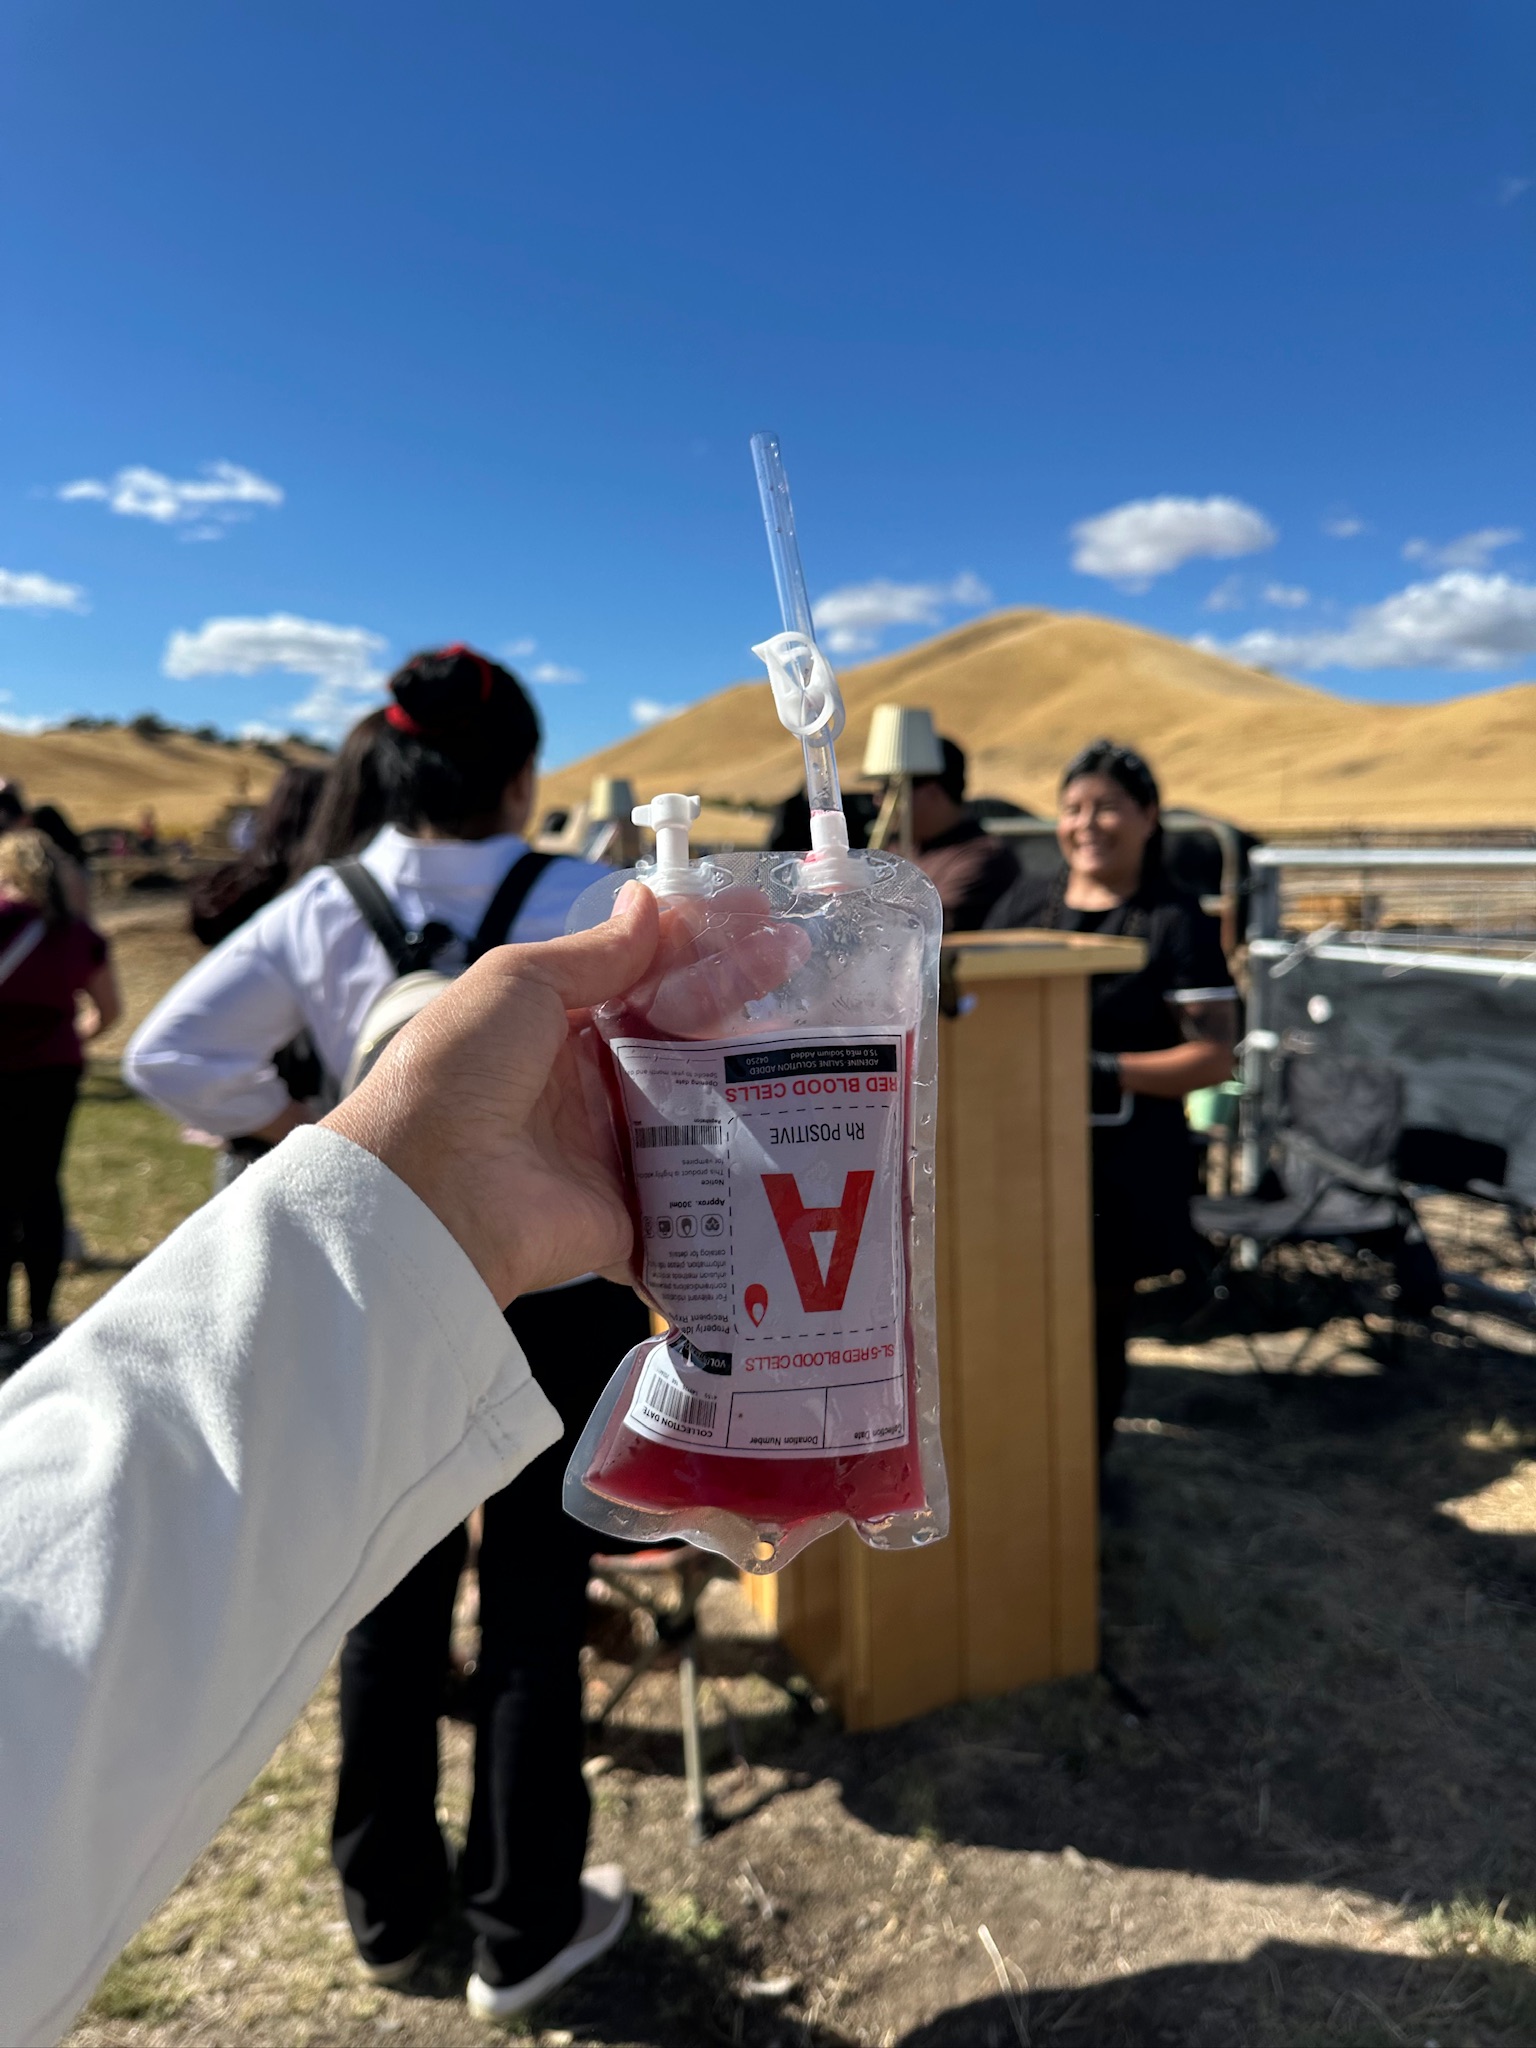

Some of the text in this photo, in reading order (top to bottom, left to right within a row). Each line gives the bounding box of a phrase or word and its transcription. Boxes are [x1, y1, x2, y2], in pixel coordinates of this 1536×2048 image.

[790, 1051, 816, 1060] Added
[816, 1050, 844, 1058] Sodium
[846, 1048, 862, 1056] mEq
[745, 1056, 768, 1065] 04250
[750, 1058, 878, 1074] ADENINE-SALINE SOLUTION ADDED
[724, 1076, 898, 1102] RED BLOOD CELLS
[769, 1122, 865, 1144] Rh POSITIVE
[682, 1158, 713, 1166] vampires
[655, 1170, 673, 1178] highly
[682, 1168, 708, 1178] product
[710, 1168, 724, 1176] This
[669, 1198, 725, 1208] Approx. 300ml
[760, 1170, 875, 1313] A
[700, 1249, 726, 1257] catalog
[688, 1294, 714, 1302] relevant
[690, 1314, 728, 1322] Recipient
[696, 1324, 729, 1334] Properly
[744, 1344, 895, 1371] SL-5 RED BLOOD CELLS
[642, 1406, 713, 1438] COLLECTION DATE
[854, 1424, 902, 1441] Collection Date
[749, 1436, 818, 1446] Donation Number
